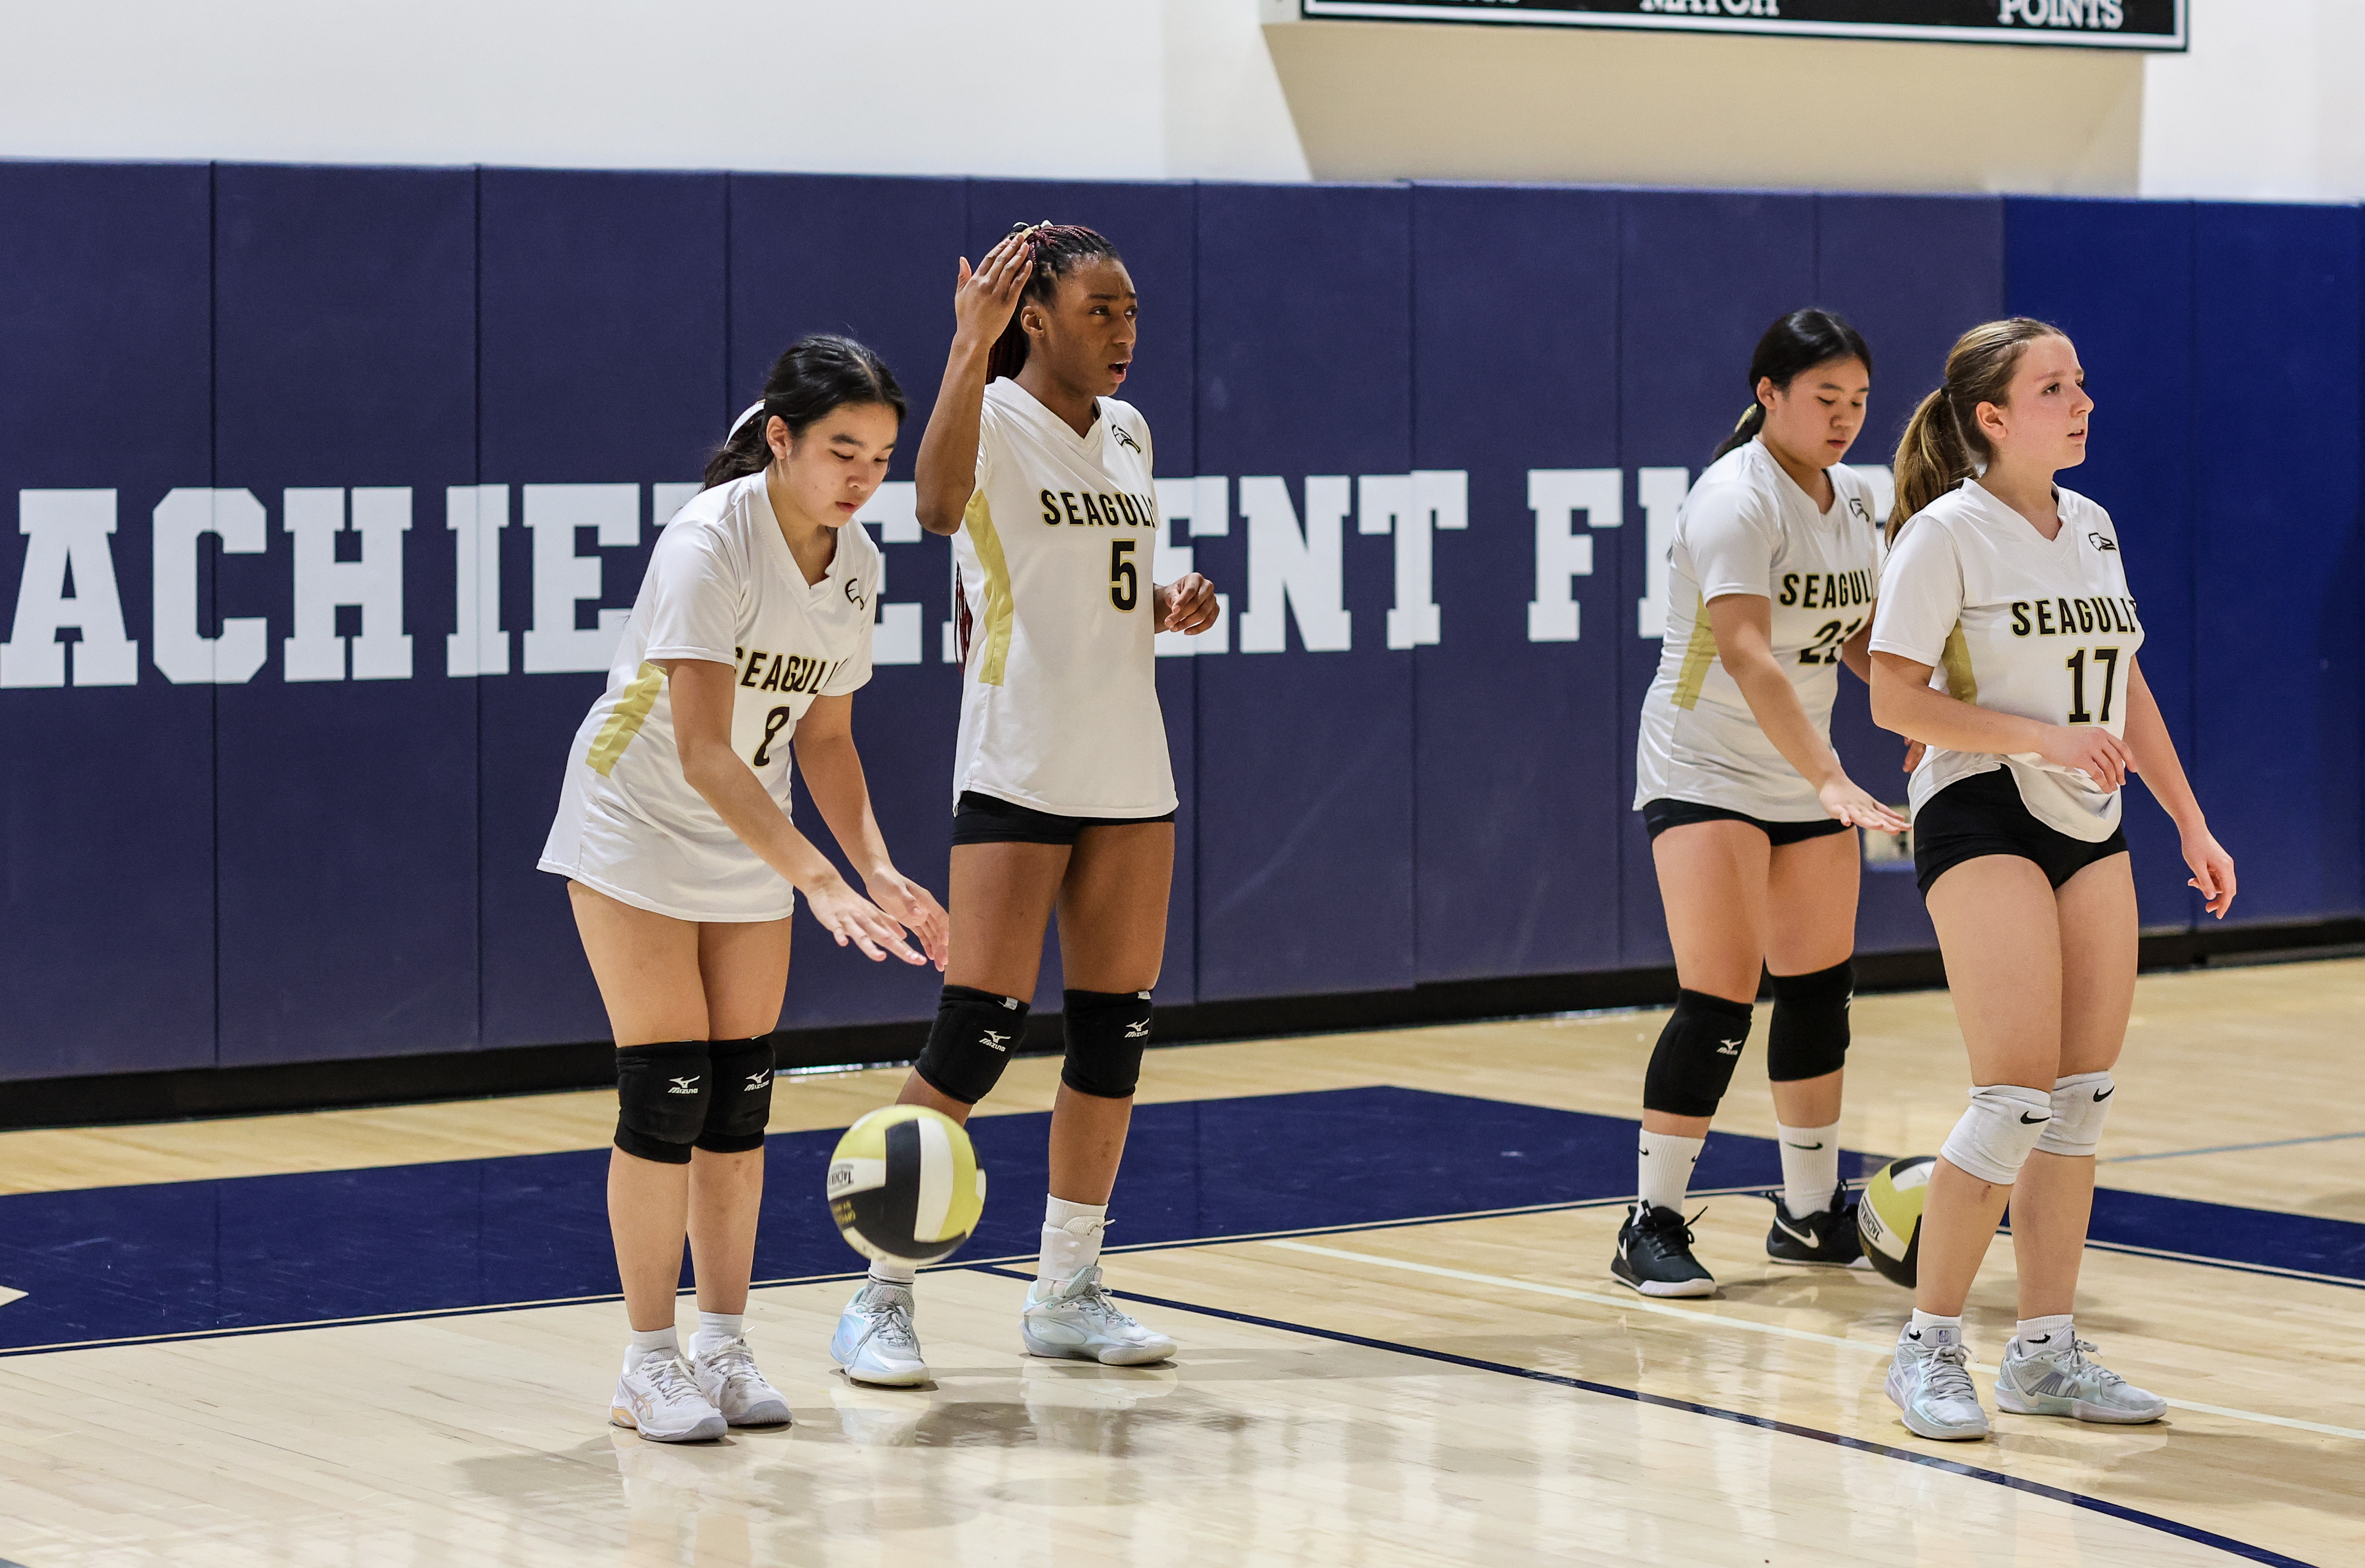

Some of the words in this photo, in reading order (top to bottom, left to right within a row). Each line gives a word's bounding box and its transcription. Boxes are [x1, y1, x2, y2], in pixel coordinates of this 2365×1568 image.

[1997, 0, 2124, 29] POINTS
[1039, 488, 1156, 529] SEAGULL
[0, 469, 1468, 688] ACHIEENT
[1109, 538, 1137, 613] 5
[1779, 568, 1874, 609] SEAGUL
[2010, 596, 2137, 638] SEAGULL
[1797, 616, 1862, 665] 21
[2066, 645, 2120, 725] 17
[751, 704, 790, 769] 8
[979, 1038, 1006, 1052] MIZUNO
[1124, 1029, 1149, 1038] MIZUNO
